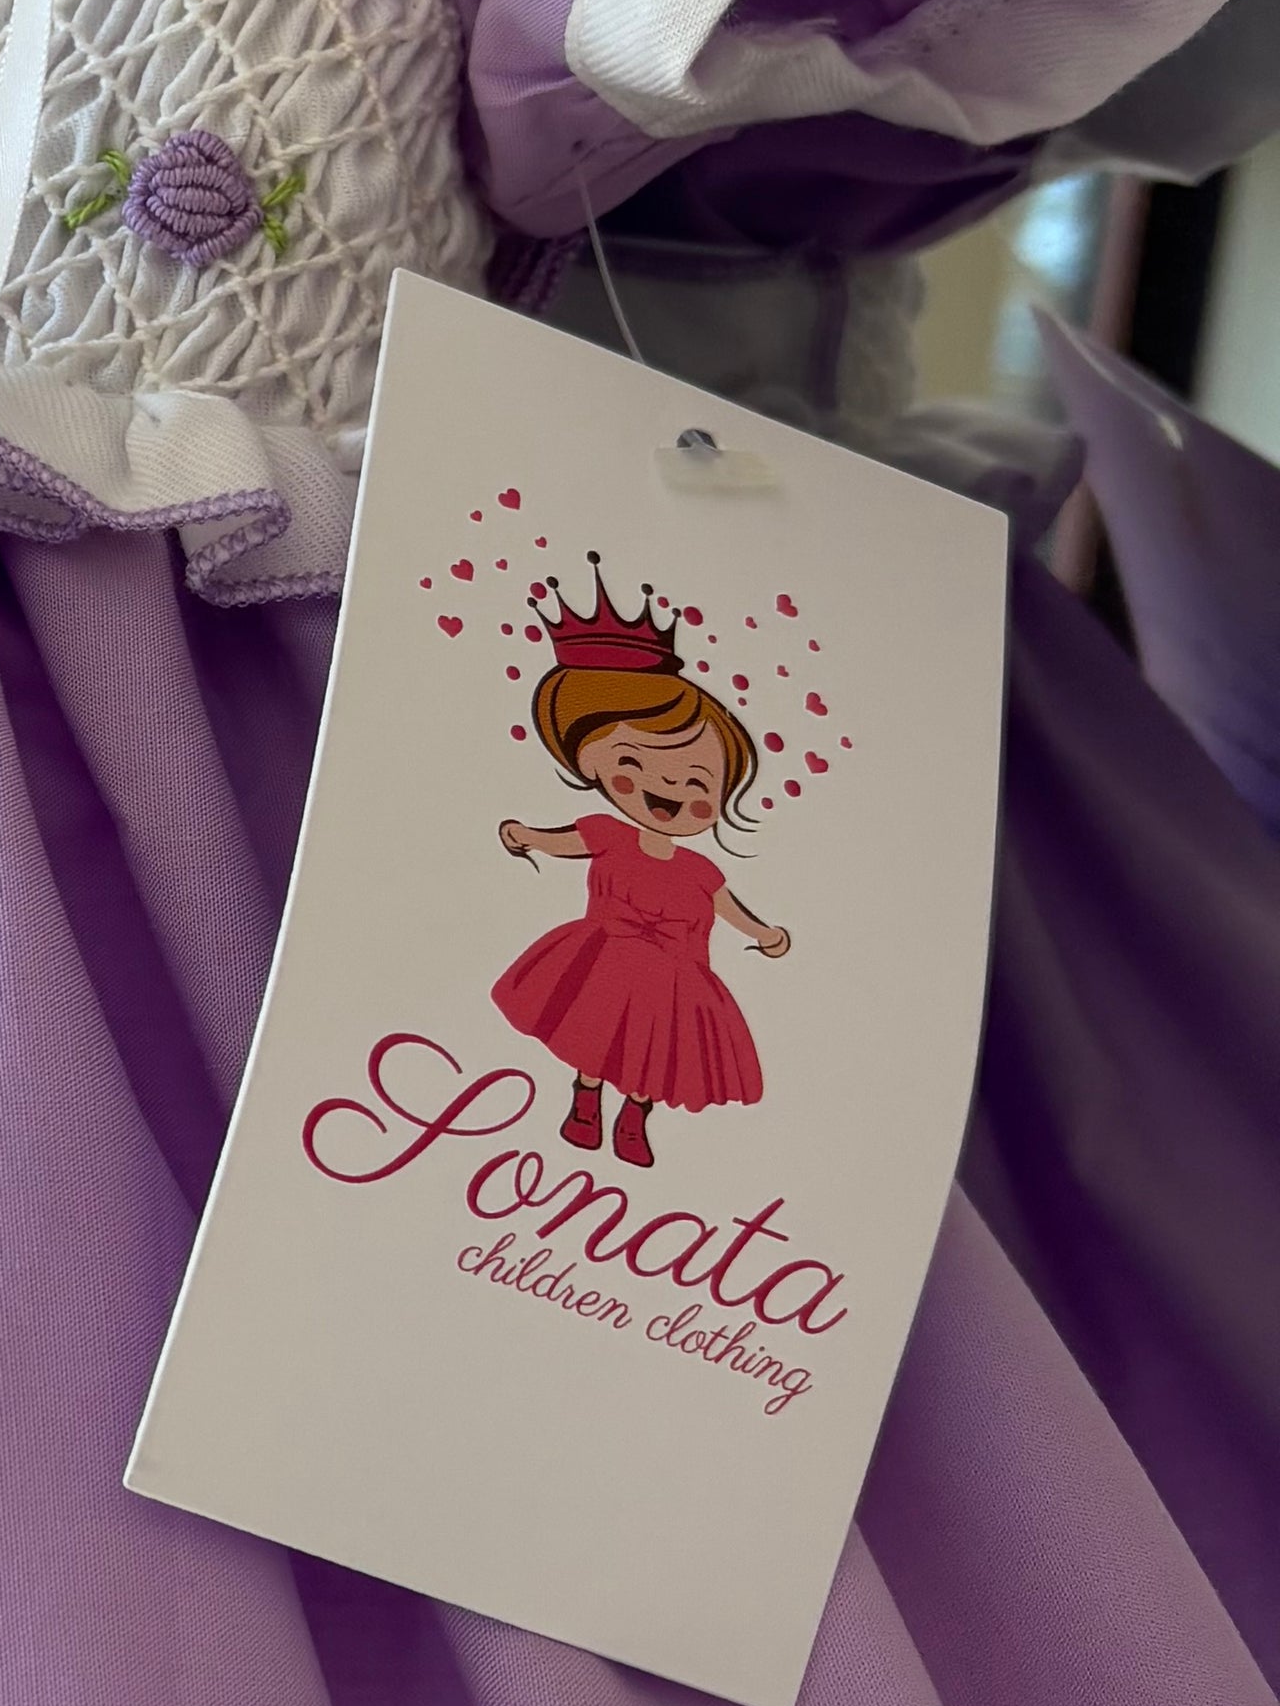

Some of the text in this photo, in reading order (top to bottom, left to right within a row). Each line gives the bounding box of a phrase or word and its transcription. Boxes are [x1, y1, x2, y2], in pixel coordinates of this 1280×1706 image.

[301, 1032, 849, 1336] Sonata
[457, 1232, 812, 1415] children clothing
